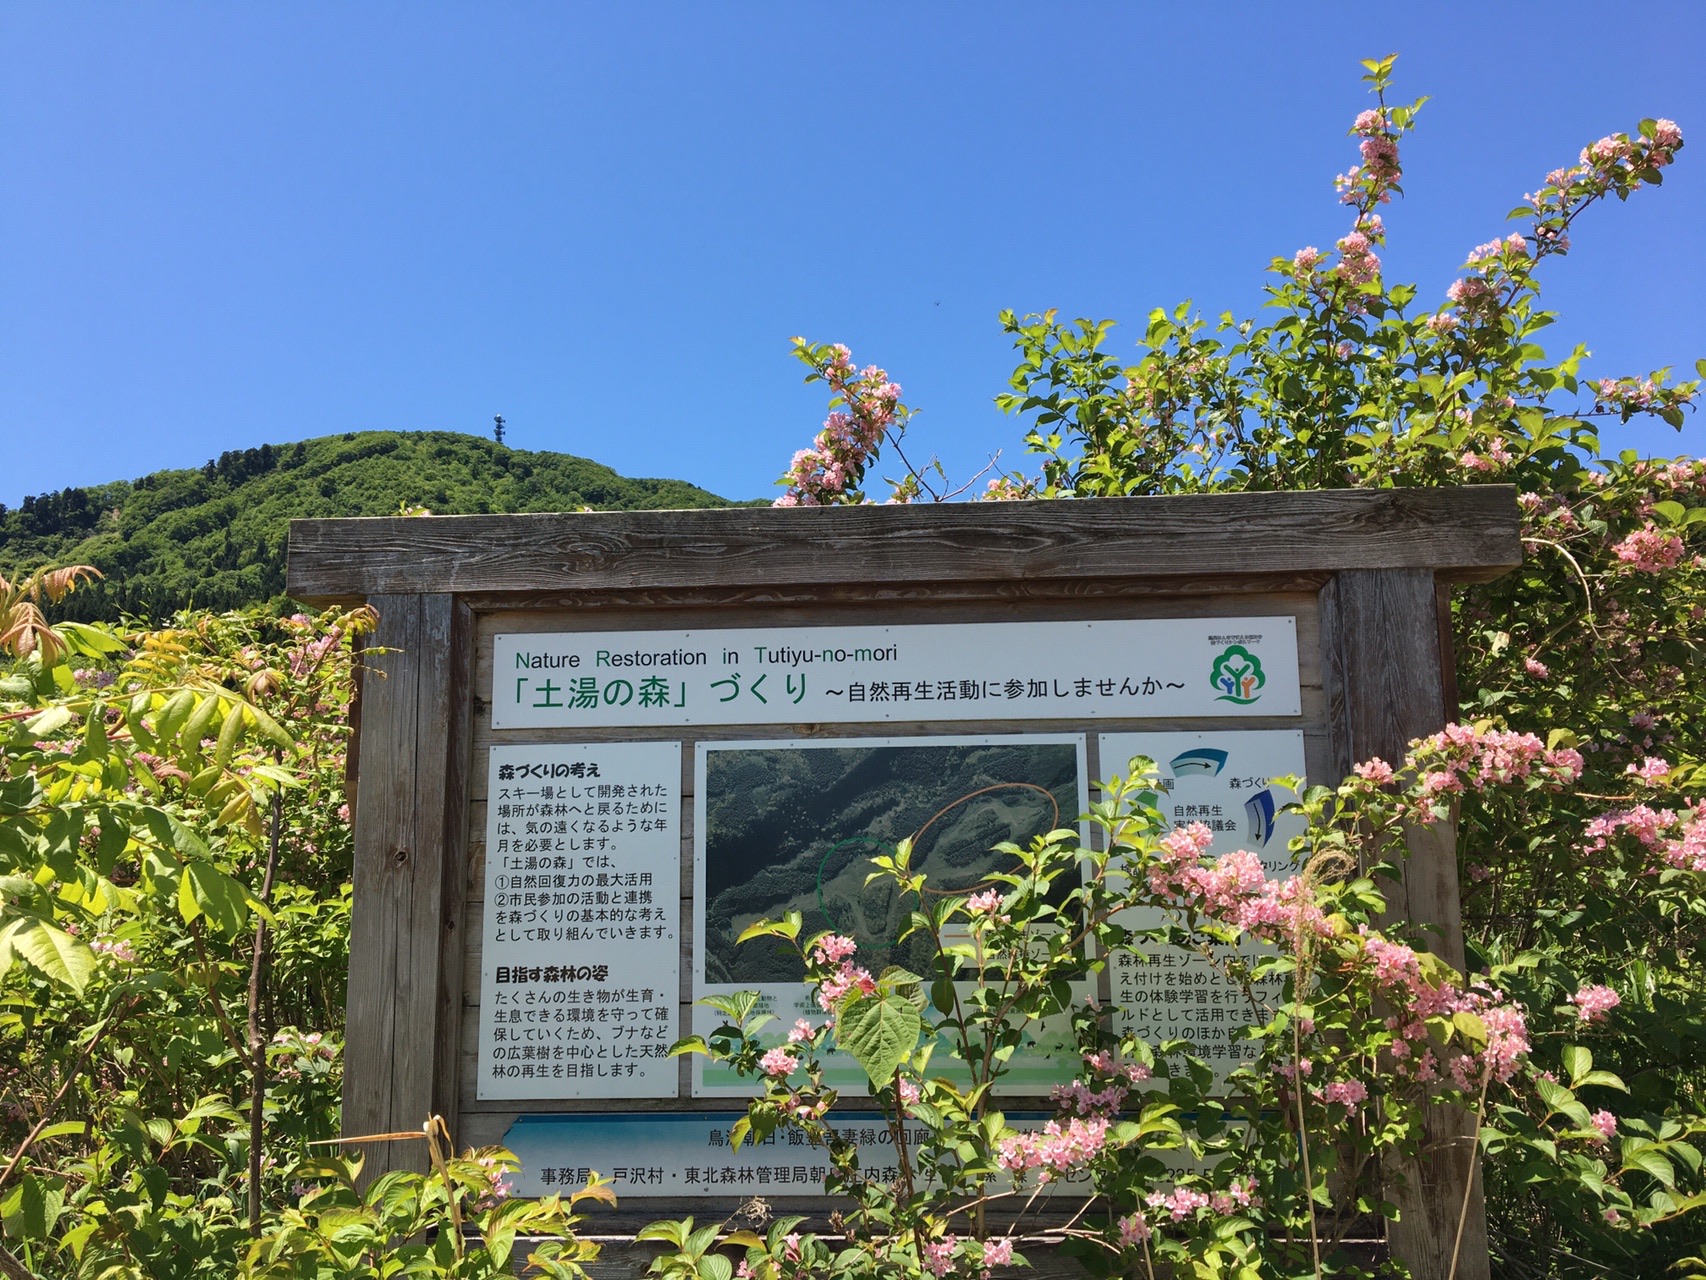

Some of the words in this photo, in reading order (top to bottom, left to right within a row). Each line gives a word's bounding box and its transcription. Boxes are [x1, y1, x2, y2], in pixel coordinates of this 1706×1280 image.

[515, 651, 580, 669] Nature
[596, 648, 707, 667] Restoration
[722, 646, 739, 665] in
[754, 644, 897, 667] Tutiyu-no-mori
[498, 762, 601, 780] 森づくりの考え
[498, 784, 668, 800] スキー場として開発された
[497, 801, 667, 818] 場所が森林へと戻るために
[1174, 804, 1223, 817] 自然再生
[497, 818, 668, 835] は、気の遠くなるような年
[497, 837, 617, 853] 月を必要とします。
[501, 855, 618, 870] 「土湯の森」では、
[495, 873, 652, 890] ①自然回復力の最大活用
[494, 890, 653, 908] ②市民参加の活動と連携
[495, 907, 667, 925] を森づくりの基本的な考え
[495, 925, 673, 942] として取り組んでいきます。
[495, 965, 609, 984] 目指す森林の姿
[495, 988, 665, 1005] たくさんの生き物が生育・
[494, 1006, 669, 1024] 生息できる環境を守って確
[493, 1025, 668, 1042] 保していくため、ブナなど
[493, 1043, 668, 1061] の広葉樹を中心とした天然
[492, 1062, 646, 1079] 林の再生を目指します。
